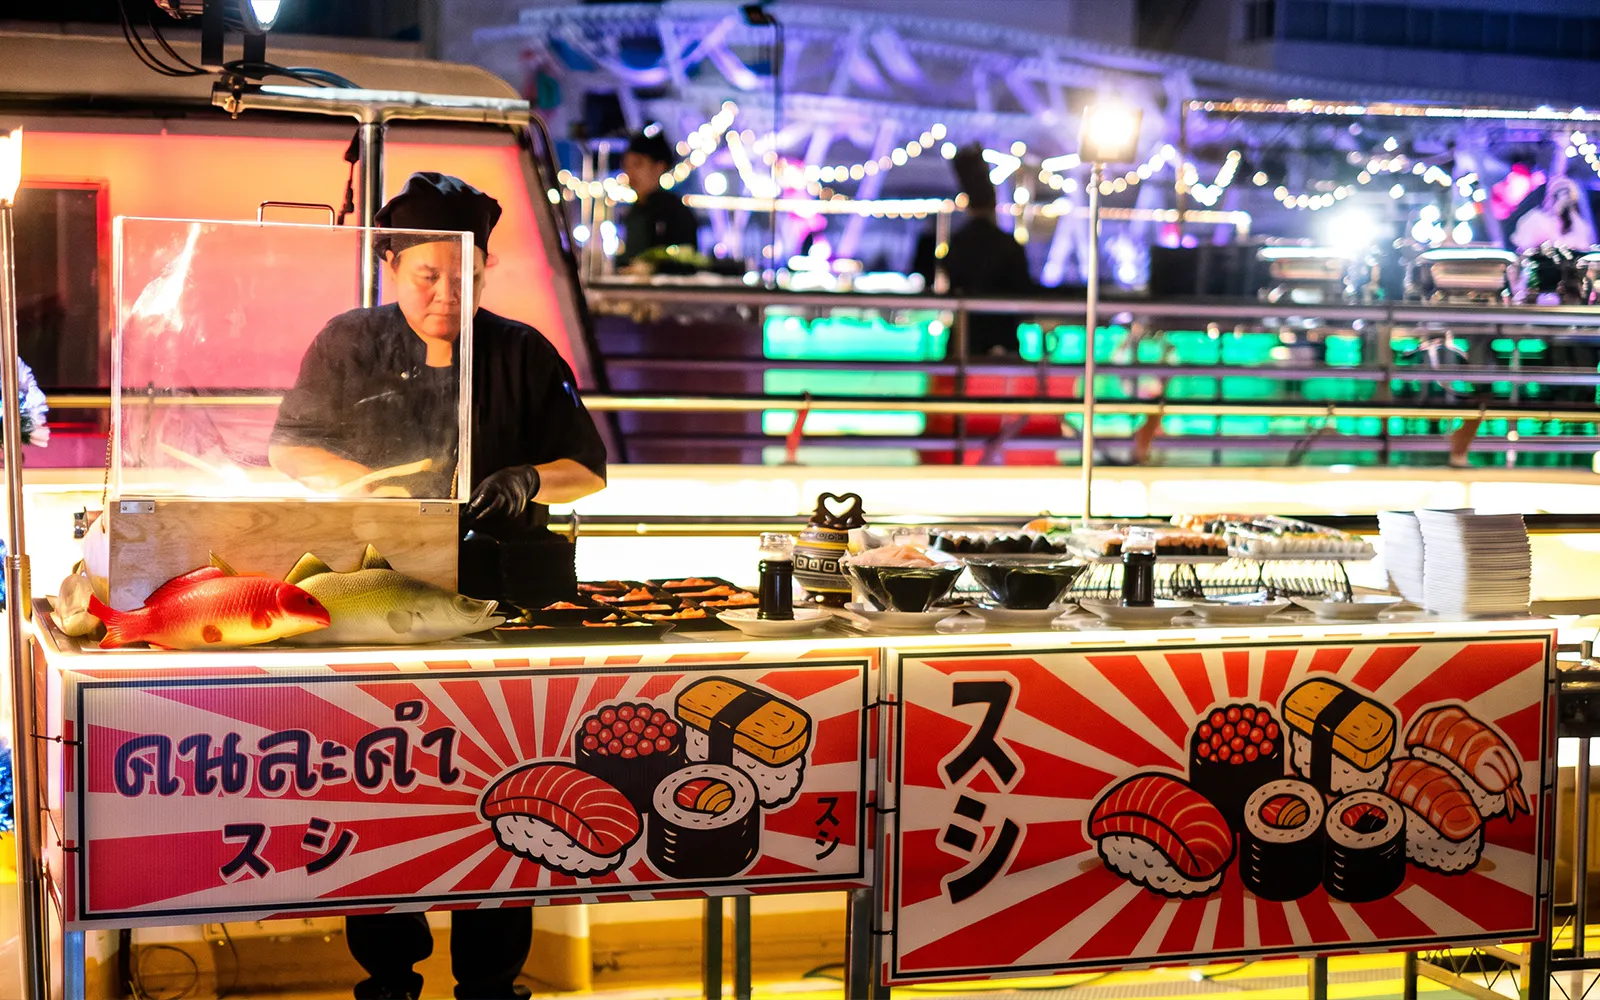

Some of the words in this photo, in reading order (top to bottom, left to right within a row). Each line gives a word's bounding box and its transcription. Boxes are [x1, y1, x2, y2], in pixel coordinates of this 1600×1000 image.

[113, 700, 461, 796] คนละคำ
[814, 797, 841, 861] スシ
[943, 681, 1020, 905] スシ
[220, 817, 356, 879] スシ
